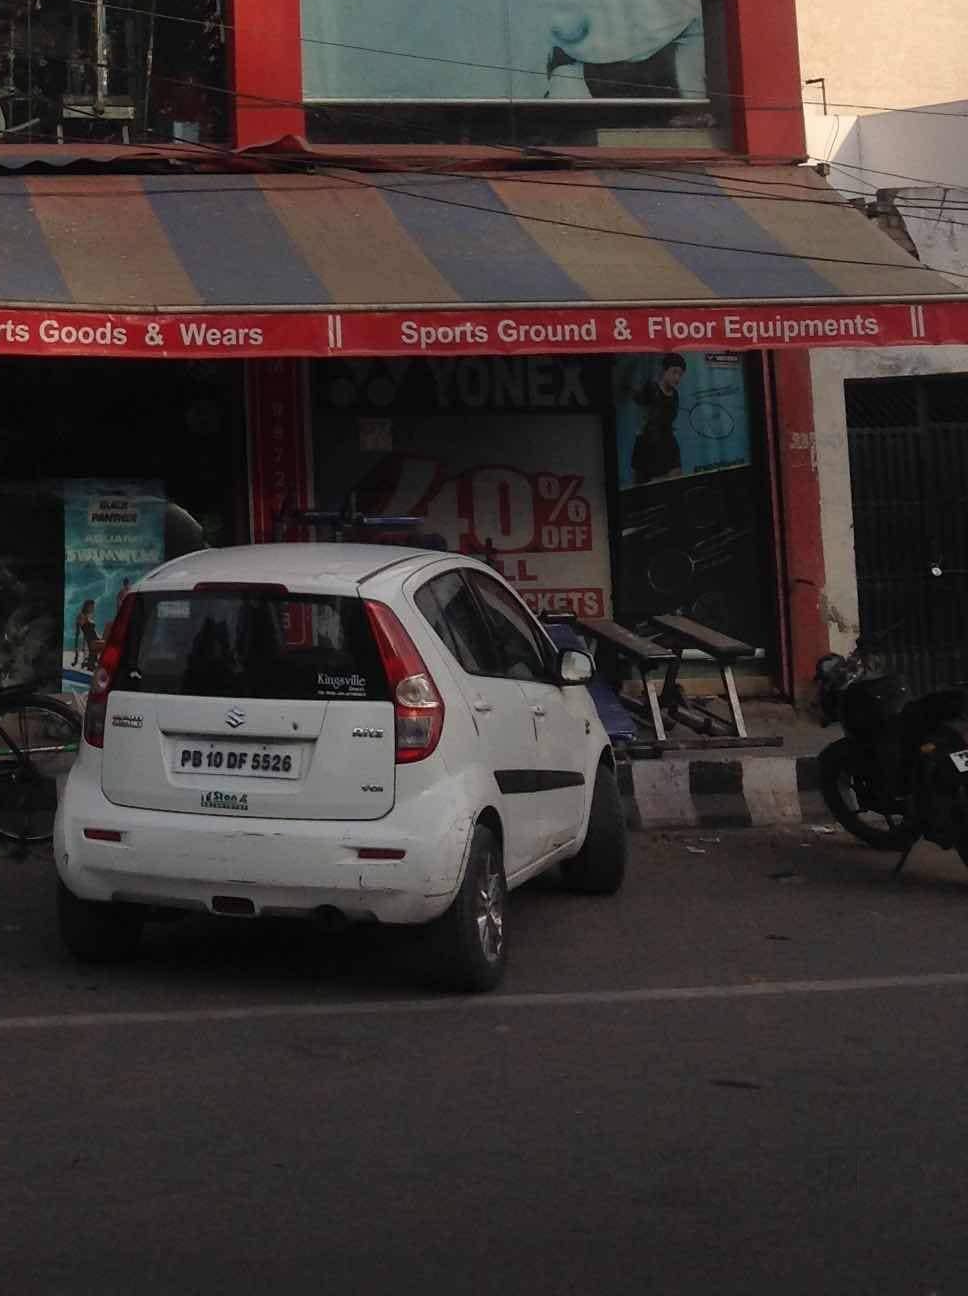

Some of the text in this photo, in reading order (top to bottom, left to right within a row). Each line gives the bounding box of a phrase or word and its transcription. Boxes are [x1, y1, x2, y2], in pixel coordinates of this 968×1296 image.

[39, 319, 127, 346] Goods
[144, 322, 164, 346] &
[180, 323, 263, 346] Wears
[401, 314, 879, 348] Sports Ground & Floor Equipments
[541, 525, 589, 550] OFF
[524, 591, 600, 617] CKETS
[181, 750, 292, 772] PB 10 DF 5526
